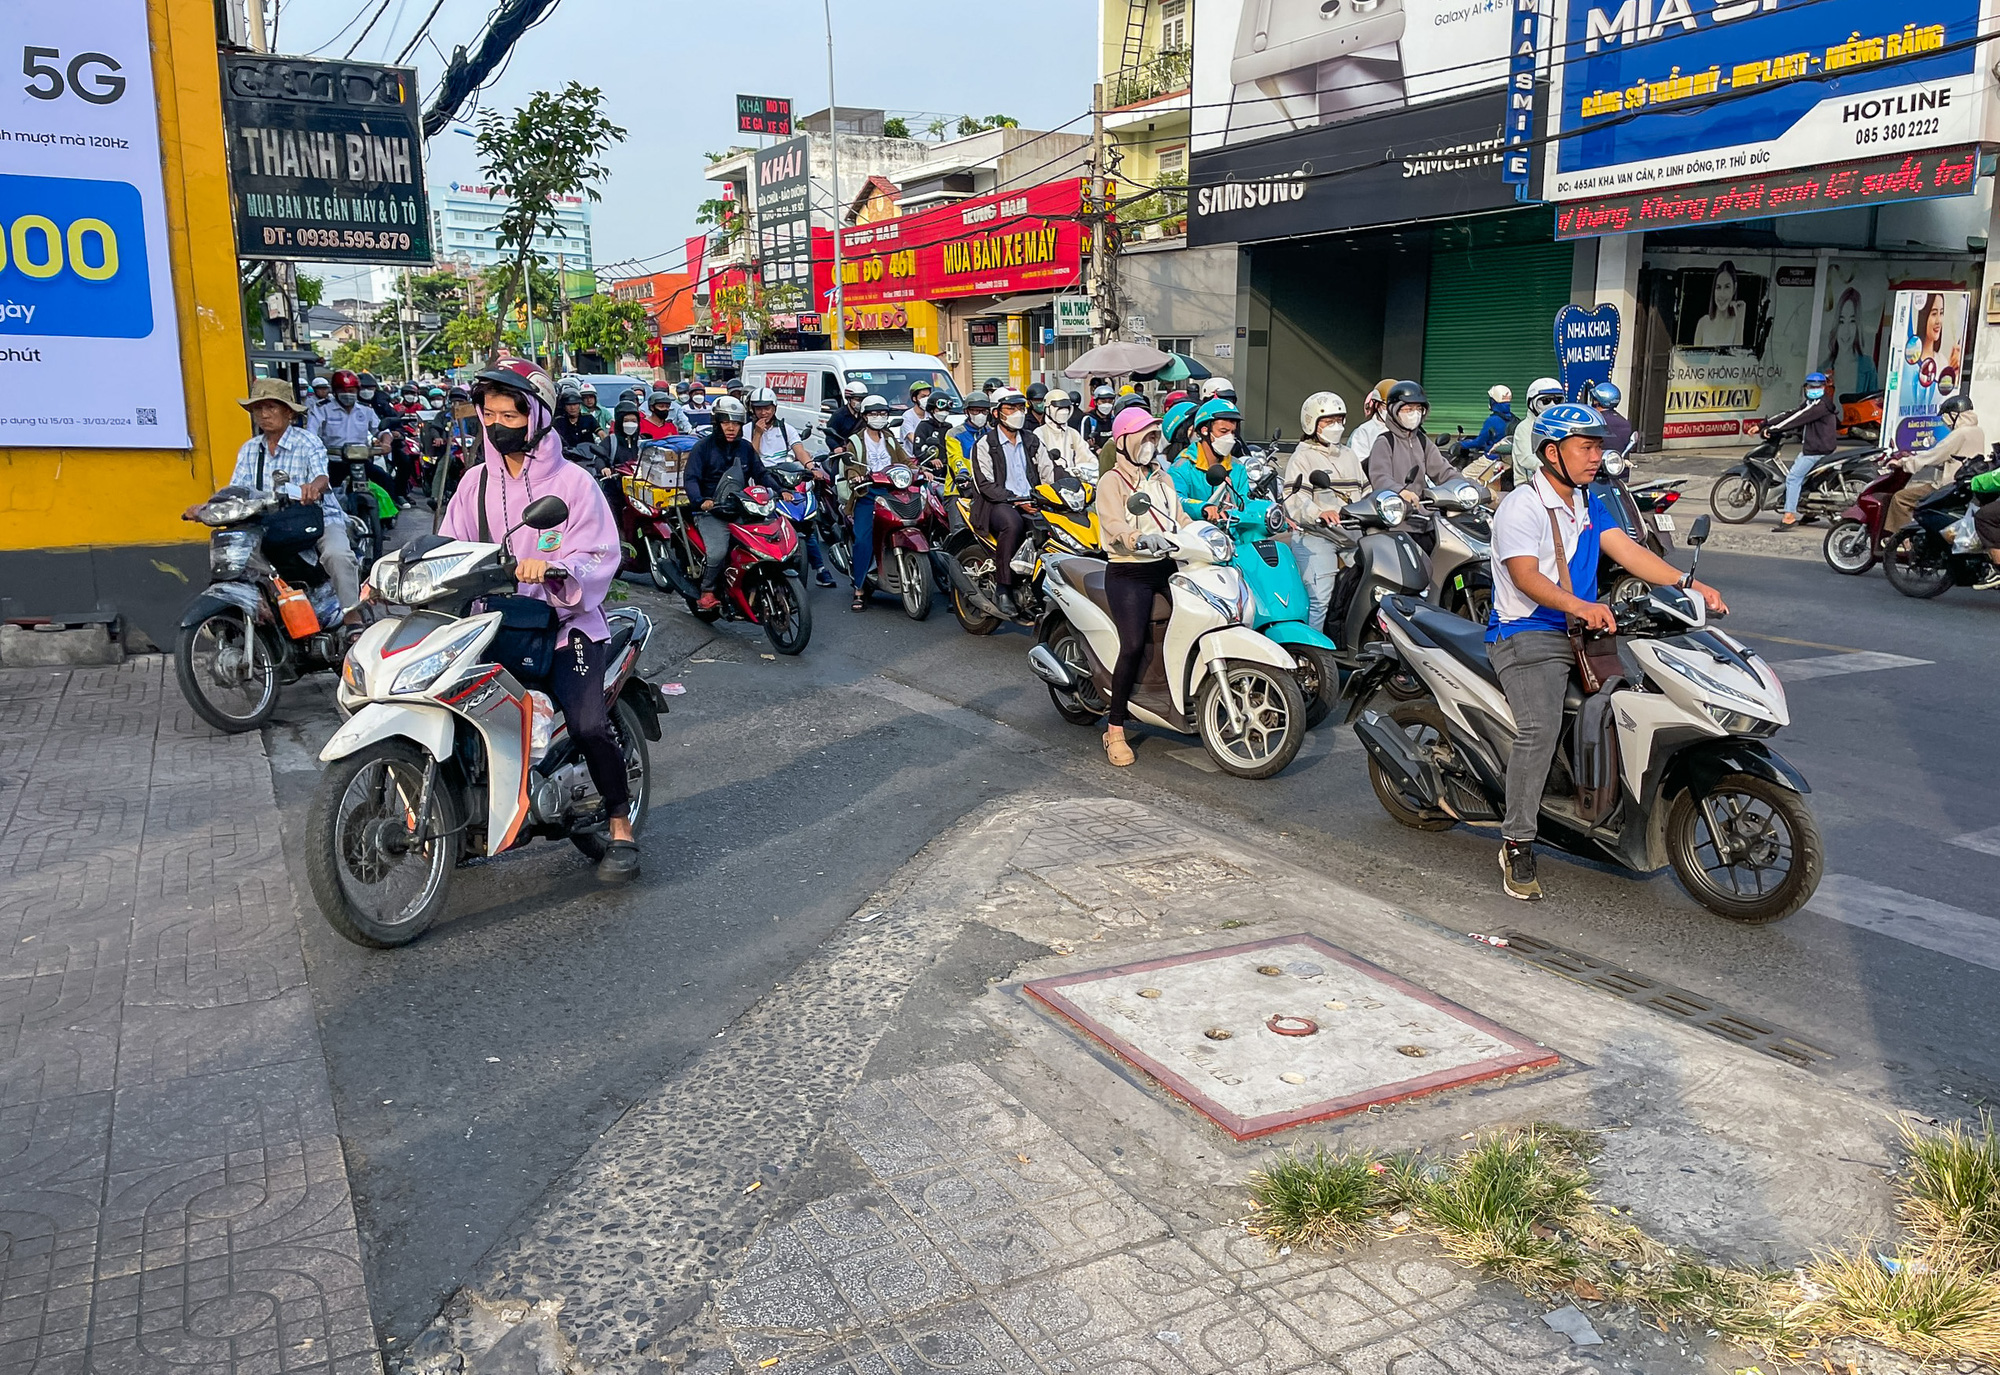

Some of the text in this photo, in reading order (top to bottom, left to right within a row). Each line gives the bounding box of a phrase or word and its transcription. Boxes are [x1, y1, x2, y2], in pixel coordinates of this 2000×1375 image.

[1434, 8, 1471, 27] Galaxy
[1472, 3, 1481, 16] AI
[1585, 0, 1697, 53] MIA
[22, 45, 127, 105] 5G
[1582, 90, 1622, 117] RĂNG
[1648, 66, 1693, 105] THẨM
[1694, 65, 1720, 95] MỸ
[1732, 52, 1809, 88] IMPLANT
[1825, 31, 1884, 70] NIỀNG
[1887, 23, 1945, 59] RĂNG
[739, 97, 763, 113] KHÁI
[1842, 88, 1951, 123] HOTLINE
[741, 116, 751, 130] XE
[752, 118, 763, 130] GA
[767, 121, 777, 134] XE
[1856, 118, 1938, 144] 085 380 2222
[15, 132, 56, 147] mượt
[60, 132, 86, 146] mà
[89, 136, 129, 149] 120Hz
[241, 122, 412, 184] THANH BÌNH
[761, 146, 802, 187] KHÁI
[1557, 181, 1572, 193] ĐC:
[1598, 176, 1614, 187] KHA
[1666, 165, 1684, 177] LINH
[1730, 151, 1746, 167] THỦ
[1198, 170, 1304, 216] SAMSUNG
[246, 193, 274, 218] MUA
[276, 189, 302, 219] BÁN
[305, 196, 322, 220] XE
[352, 193, 376, 223] MÁY
[401, 196, 417, 225] TÔ
[263, 227, 293, 246] ĐT:
[296, 228, 411, 251] 0938.595.879
[943, 241, 972, 275] MUA
[973, 231, 1001, 270] BÁN
[1003, 234, 1023, 267] XE
[1024, 218, 1058, 264] MÁY
[889, 250, 916, 278] 461
[1567, 320, 1611, 339] NHA KHOA
[1566, 344, 1611, 363] MIA SMILE
[1677, 366, 1705, 380] RĂNG
[1707, 365, 1739, 379] KHÔNG
[1667, 389, 1754, 411] INVISALIGN
[10, 417, 36, 426] dụng
[50, 417, 74, 425] 15/03
[82, 417, 131, 425] 31/03/2024
